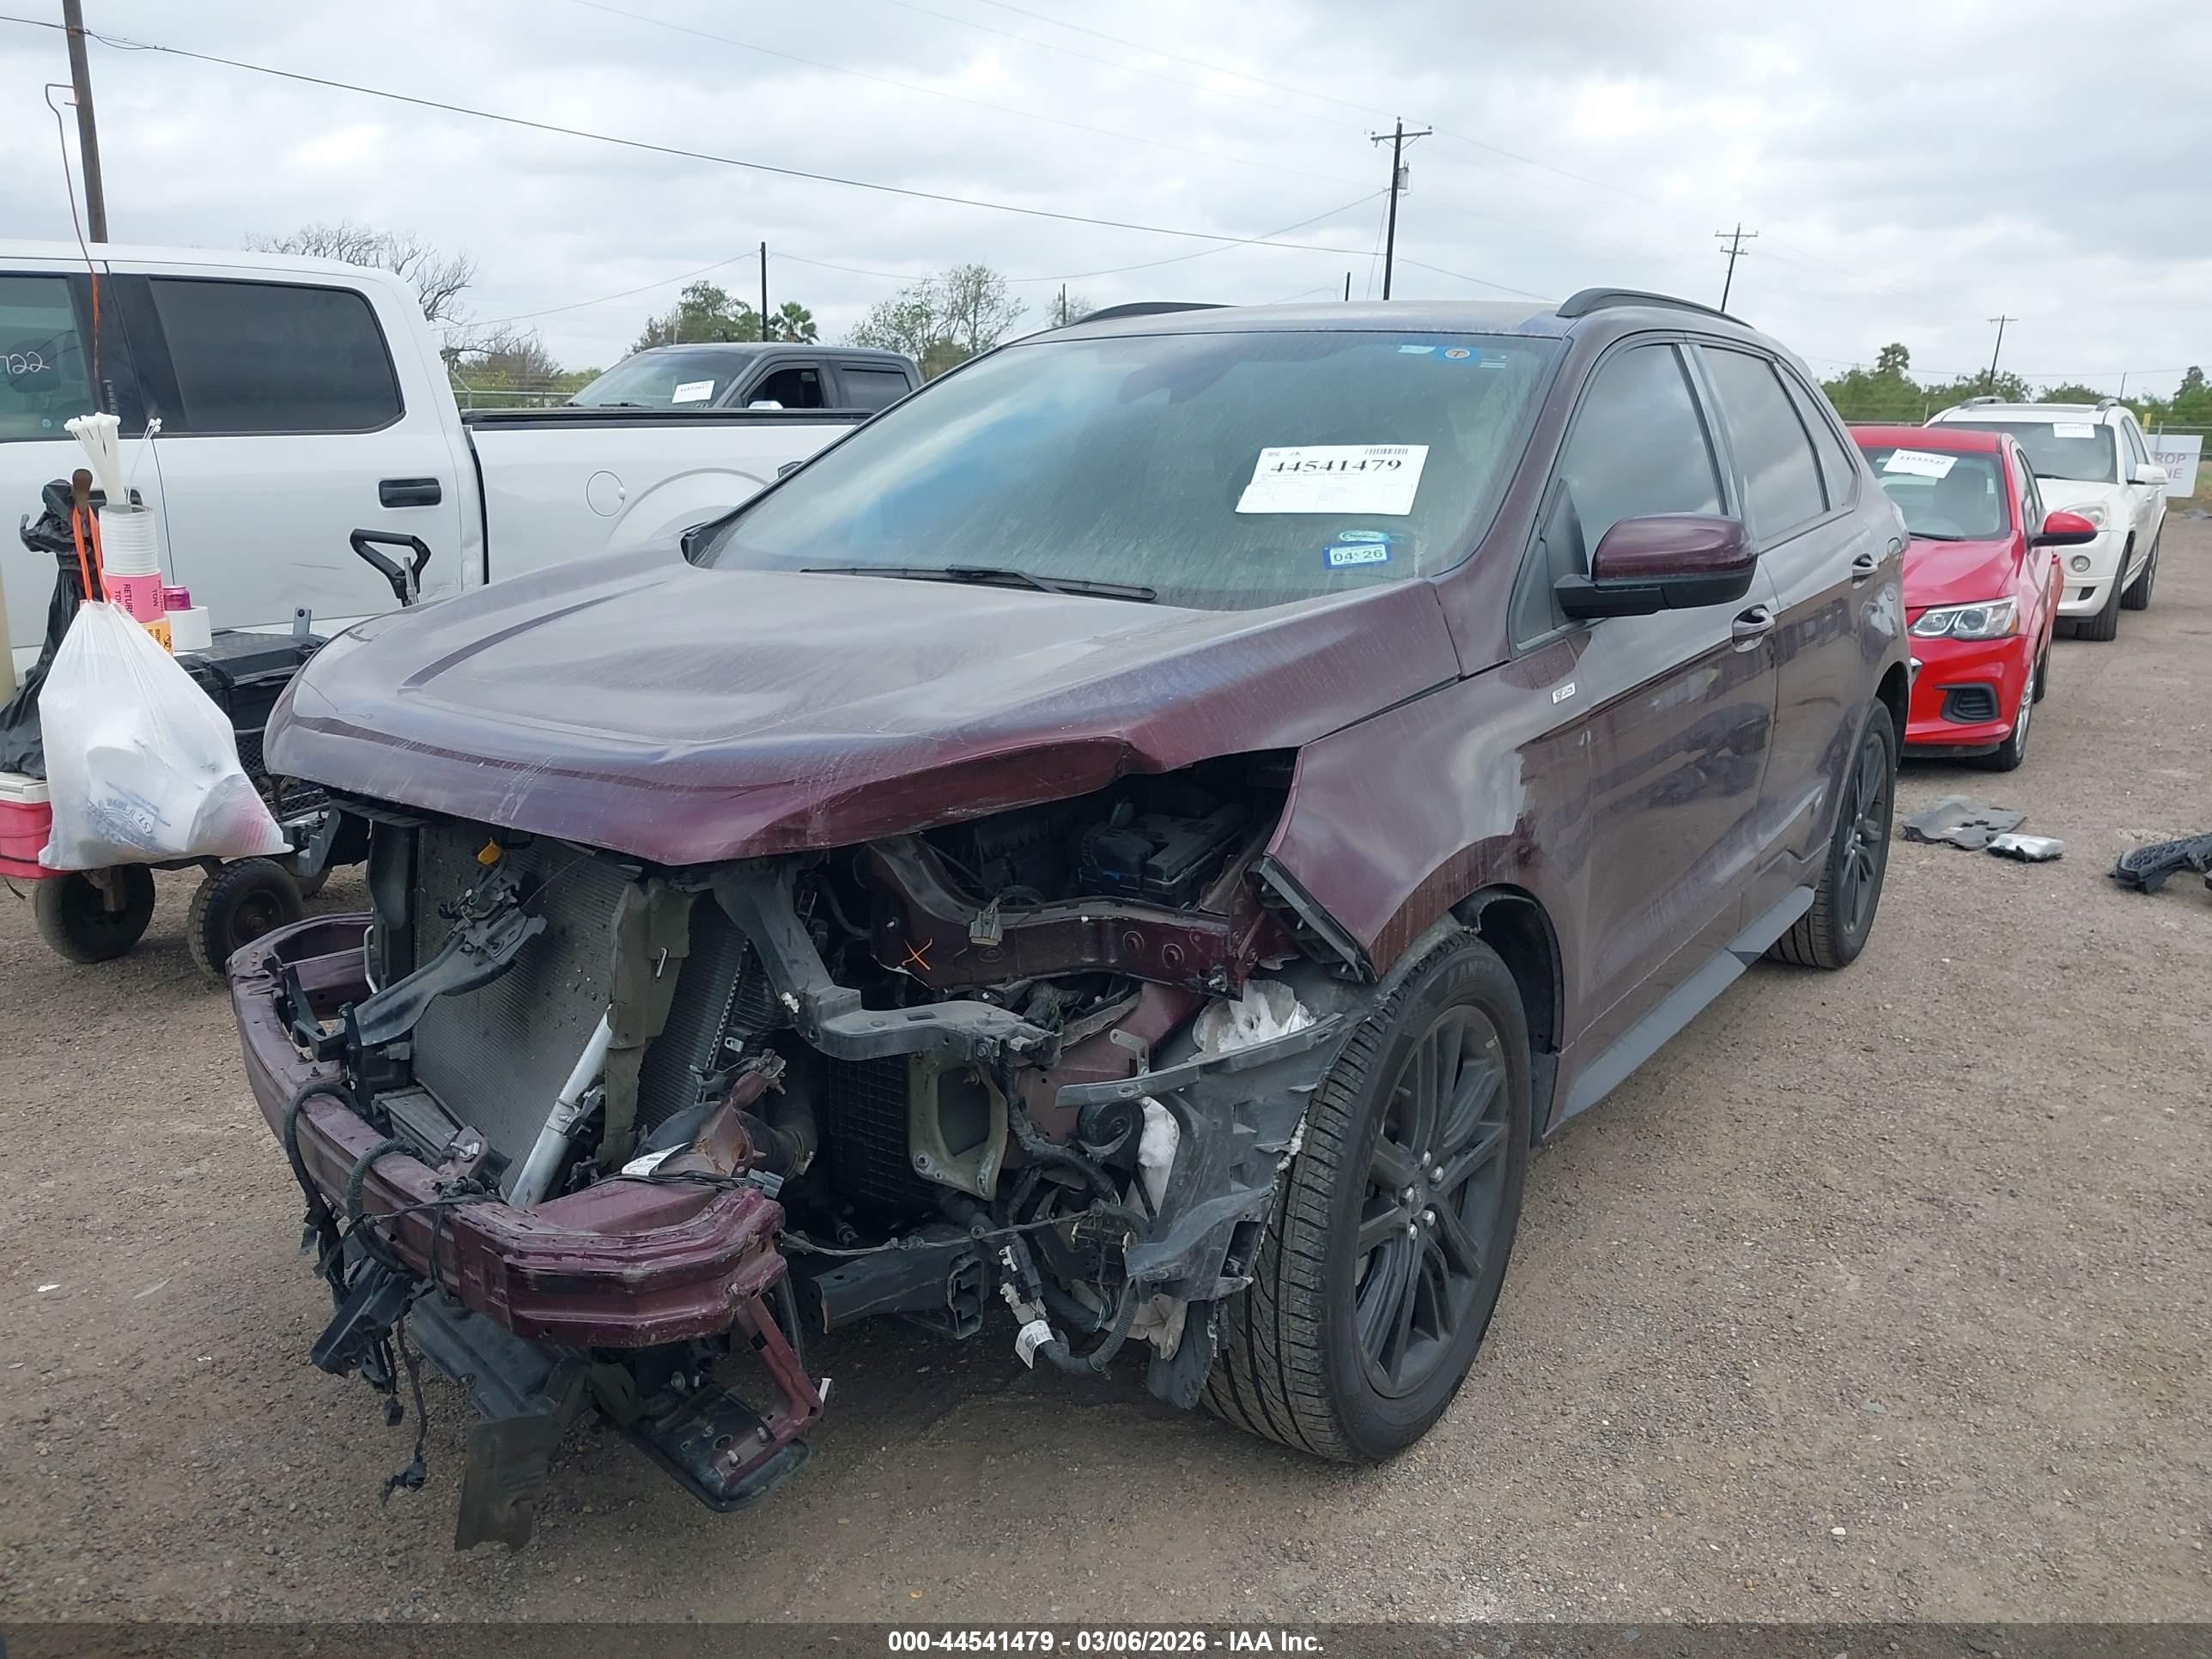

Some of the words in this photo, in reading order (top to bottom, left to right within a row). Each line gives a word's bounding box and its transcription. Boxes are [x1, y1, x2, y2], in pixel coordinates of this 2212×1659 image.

[2150, 453, 2186, 464] ROP
[1270, 459, 1402, 473] 44541479
[1333, 552, 1353, 562] 04
[1362, 550, 1383, 560] 26
